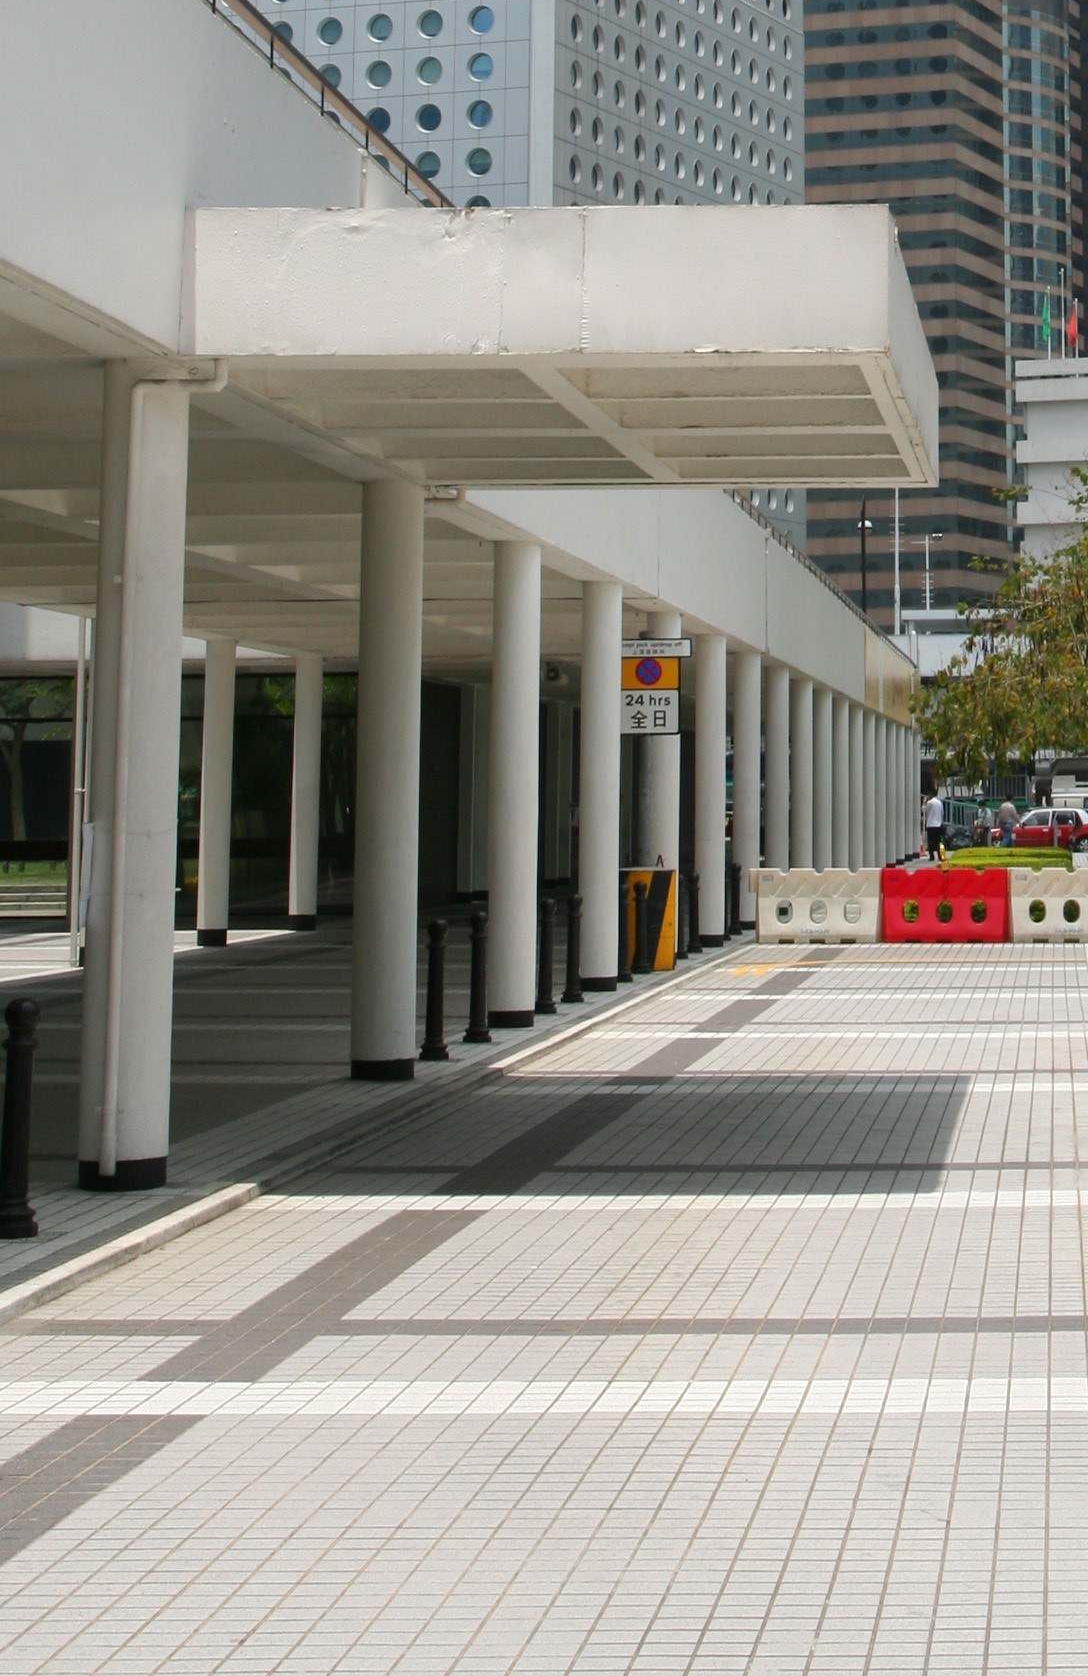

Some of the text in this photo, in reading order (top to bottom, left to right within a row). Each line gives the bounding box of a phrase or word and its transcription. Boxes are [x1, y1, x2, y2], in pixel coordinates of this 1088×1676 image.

[625, 694, 670, 706] 24 hrs
[631, 710, 666, 728] 全日
